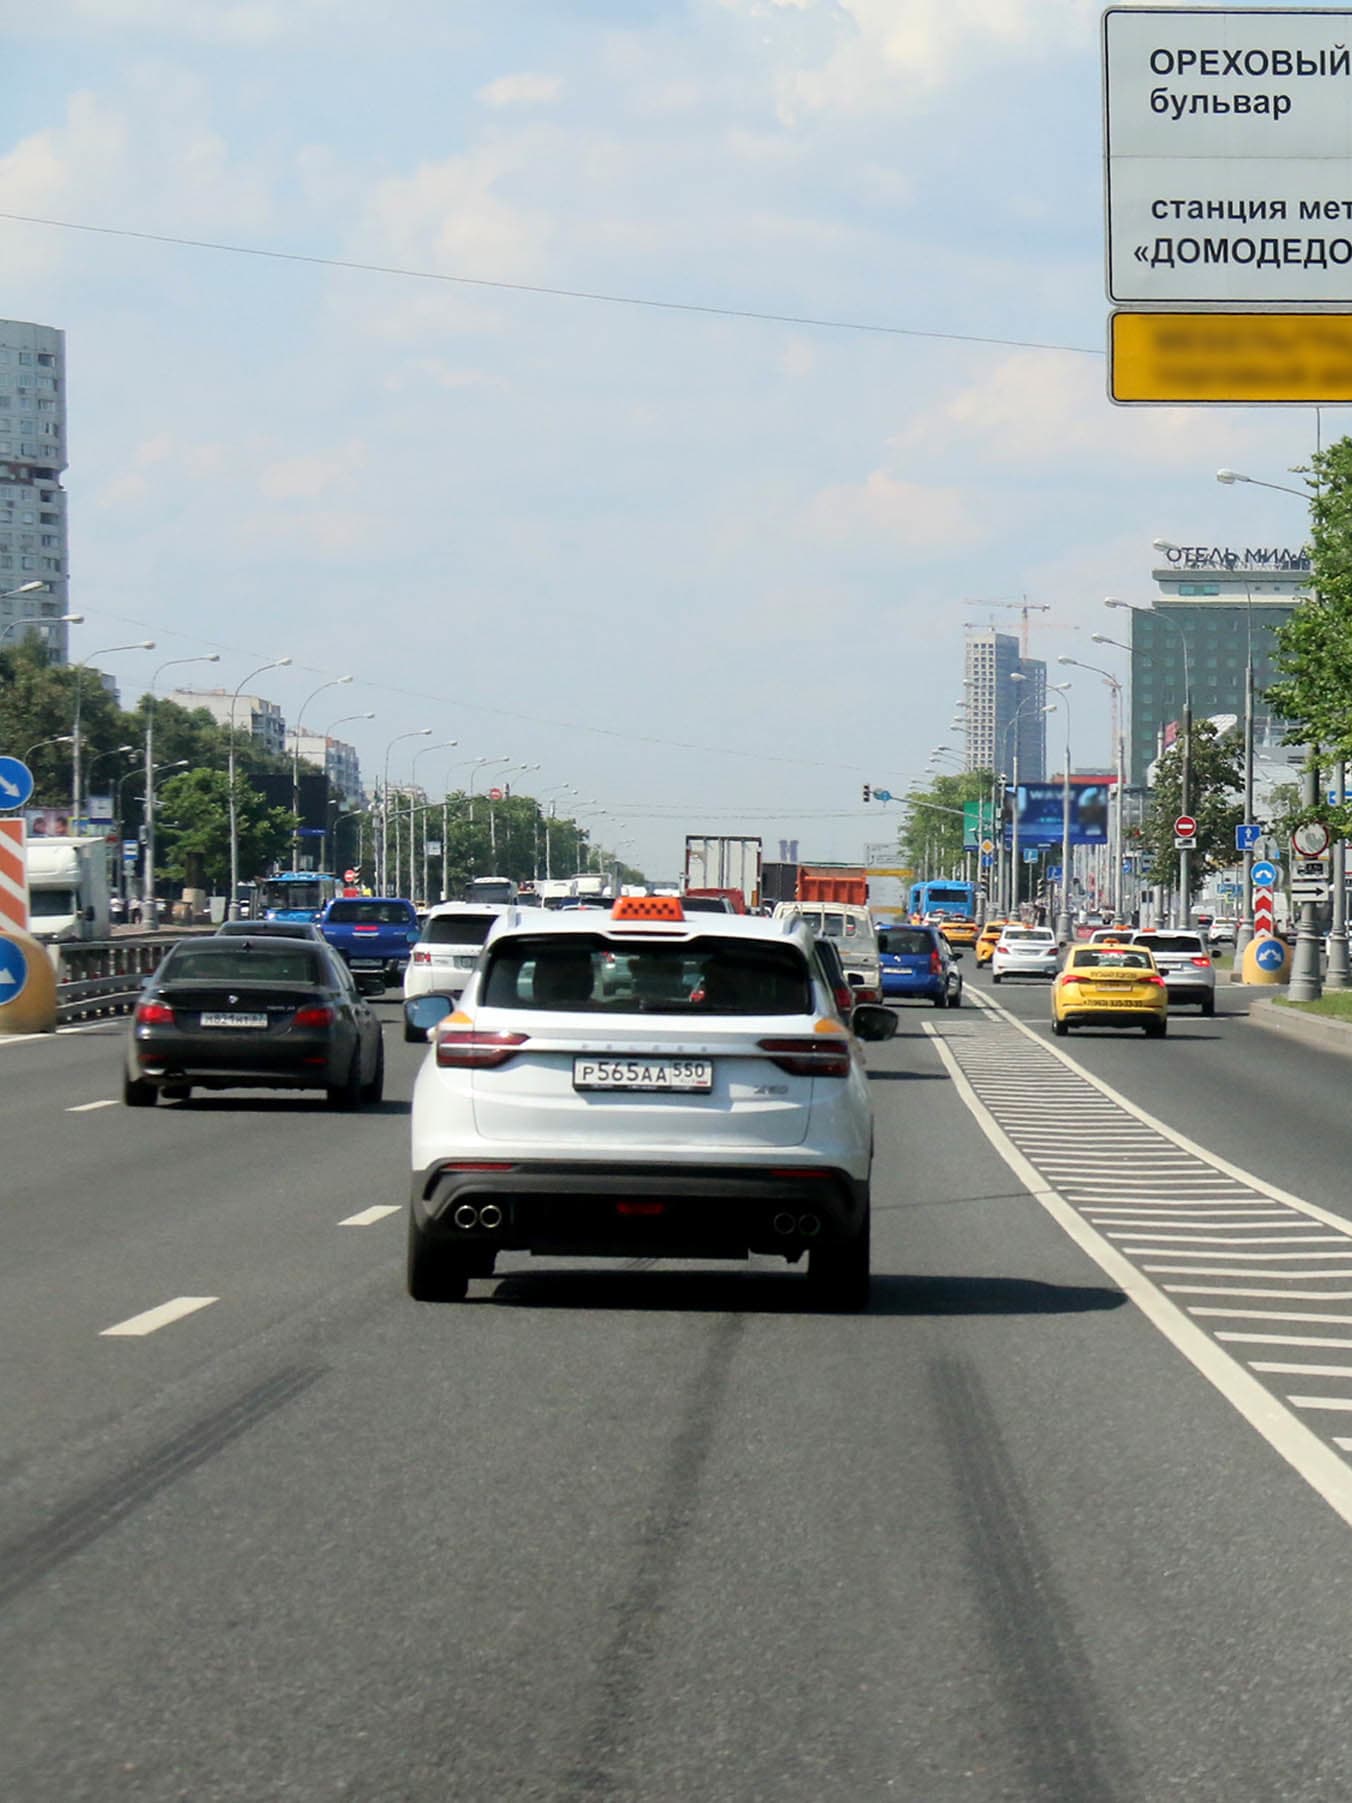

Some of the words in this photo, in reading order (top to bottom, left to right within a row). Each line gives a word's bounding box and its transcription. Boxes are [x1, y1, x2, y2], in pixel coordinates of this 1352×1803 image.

[1149, 44, 1351, 76] ОРЕХОВЫЙ
[1150, 87, 1292, 120] бульвар
[1151, 199, 1287, 223] станция
[1166, 547, 1239, 564] ОТЕЛЬ
[672, 1062, 705, 1078] 550
